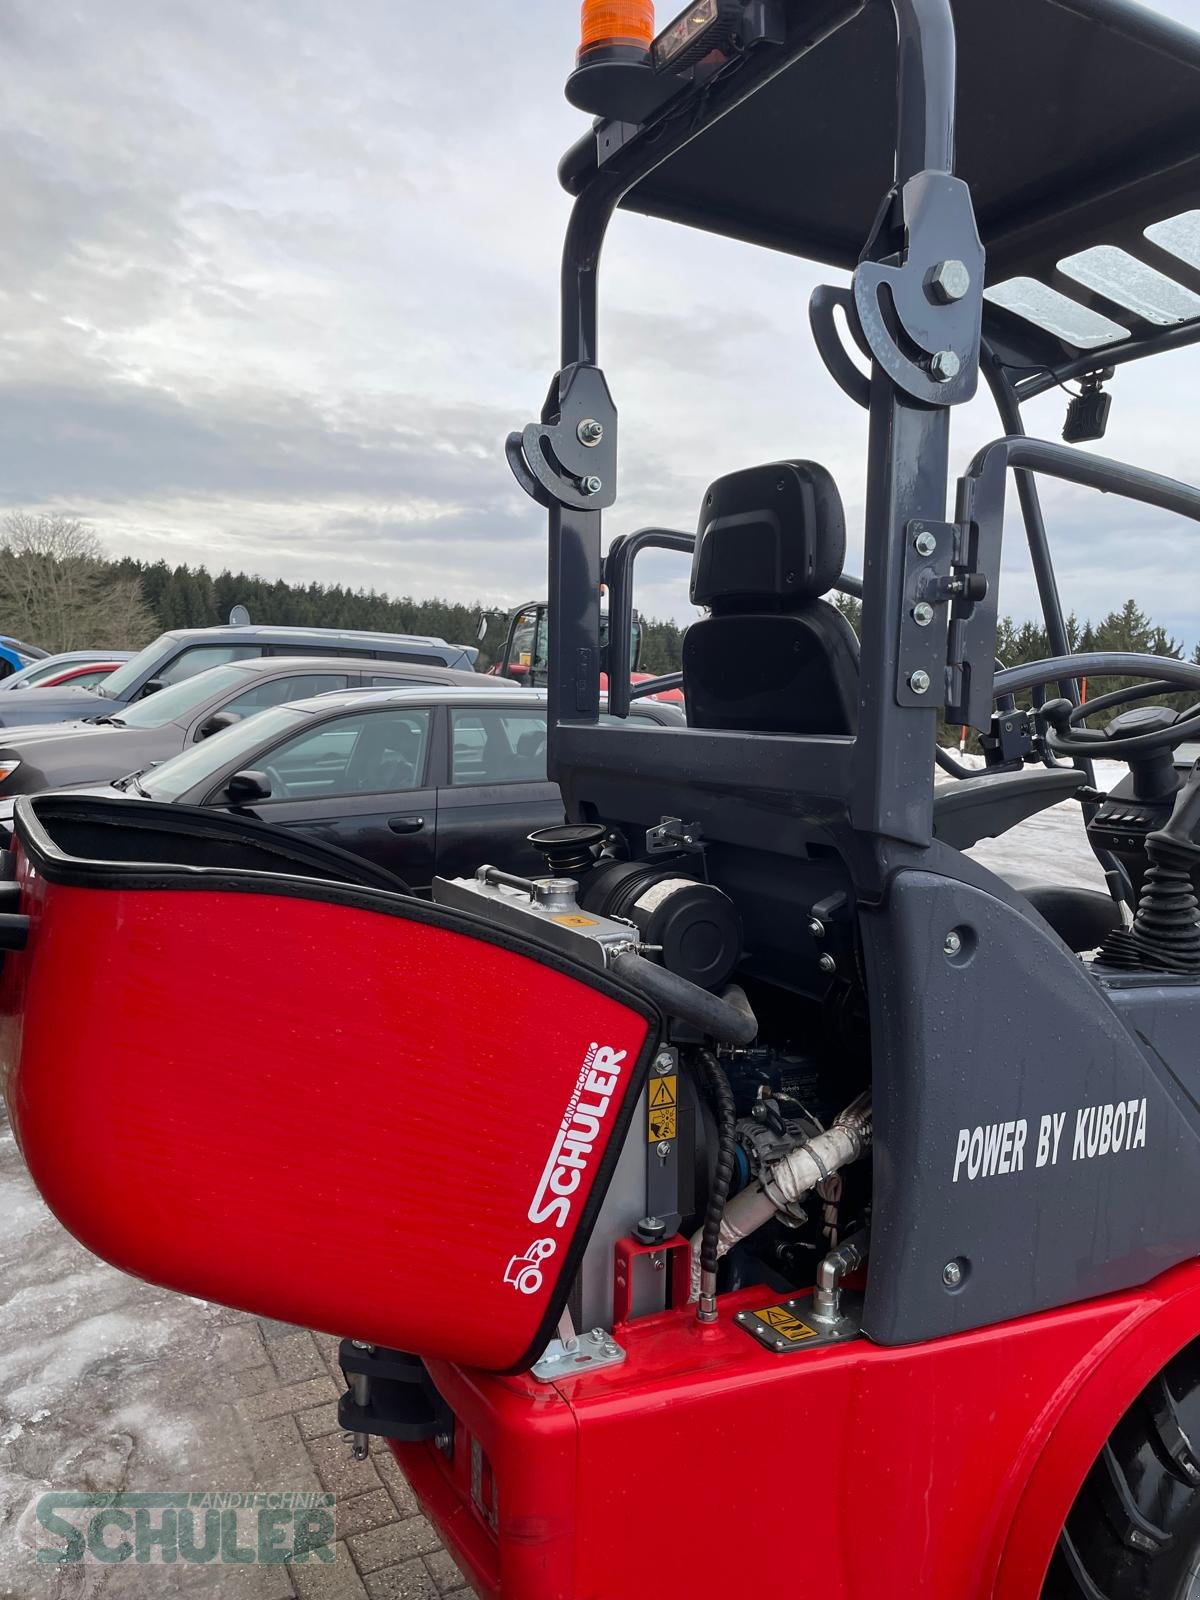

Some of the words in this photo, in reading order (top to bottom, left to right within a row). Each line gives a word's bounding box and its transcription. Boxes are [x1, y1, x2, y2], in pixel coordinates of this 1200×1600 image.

[528, 1043, 627, 1228] SCHULER
[952, 1118, 1028, 1183] POWER
[1035, 1111, 1066, 1168] BY
[1072, 1098, 1147, 1161] KUBOTA
